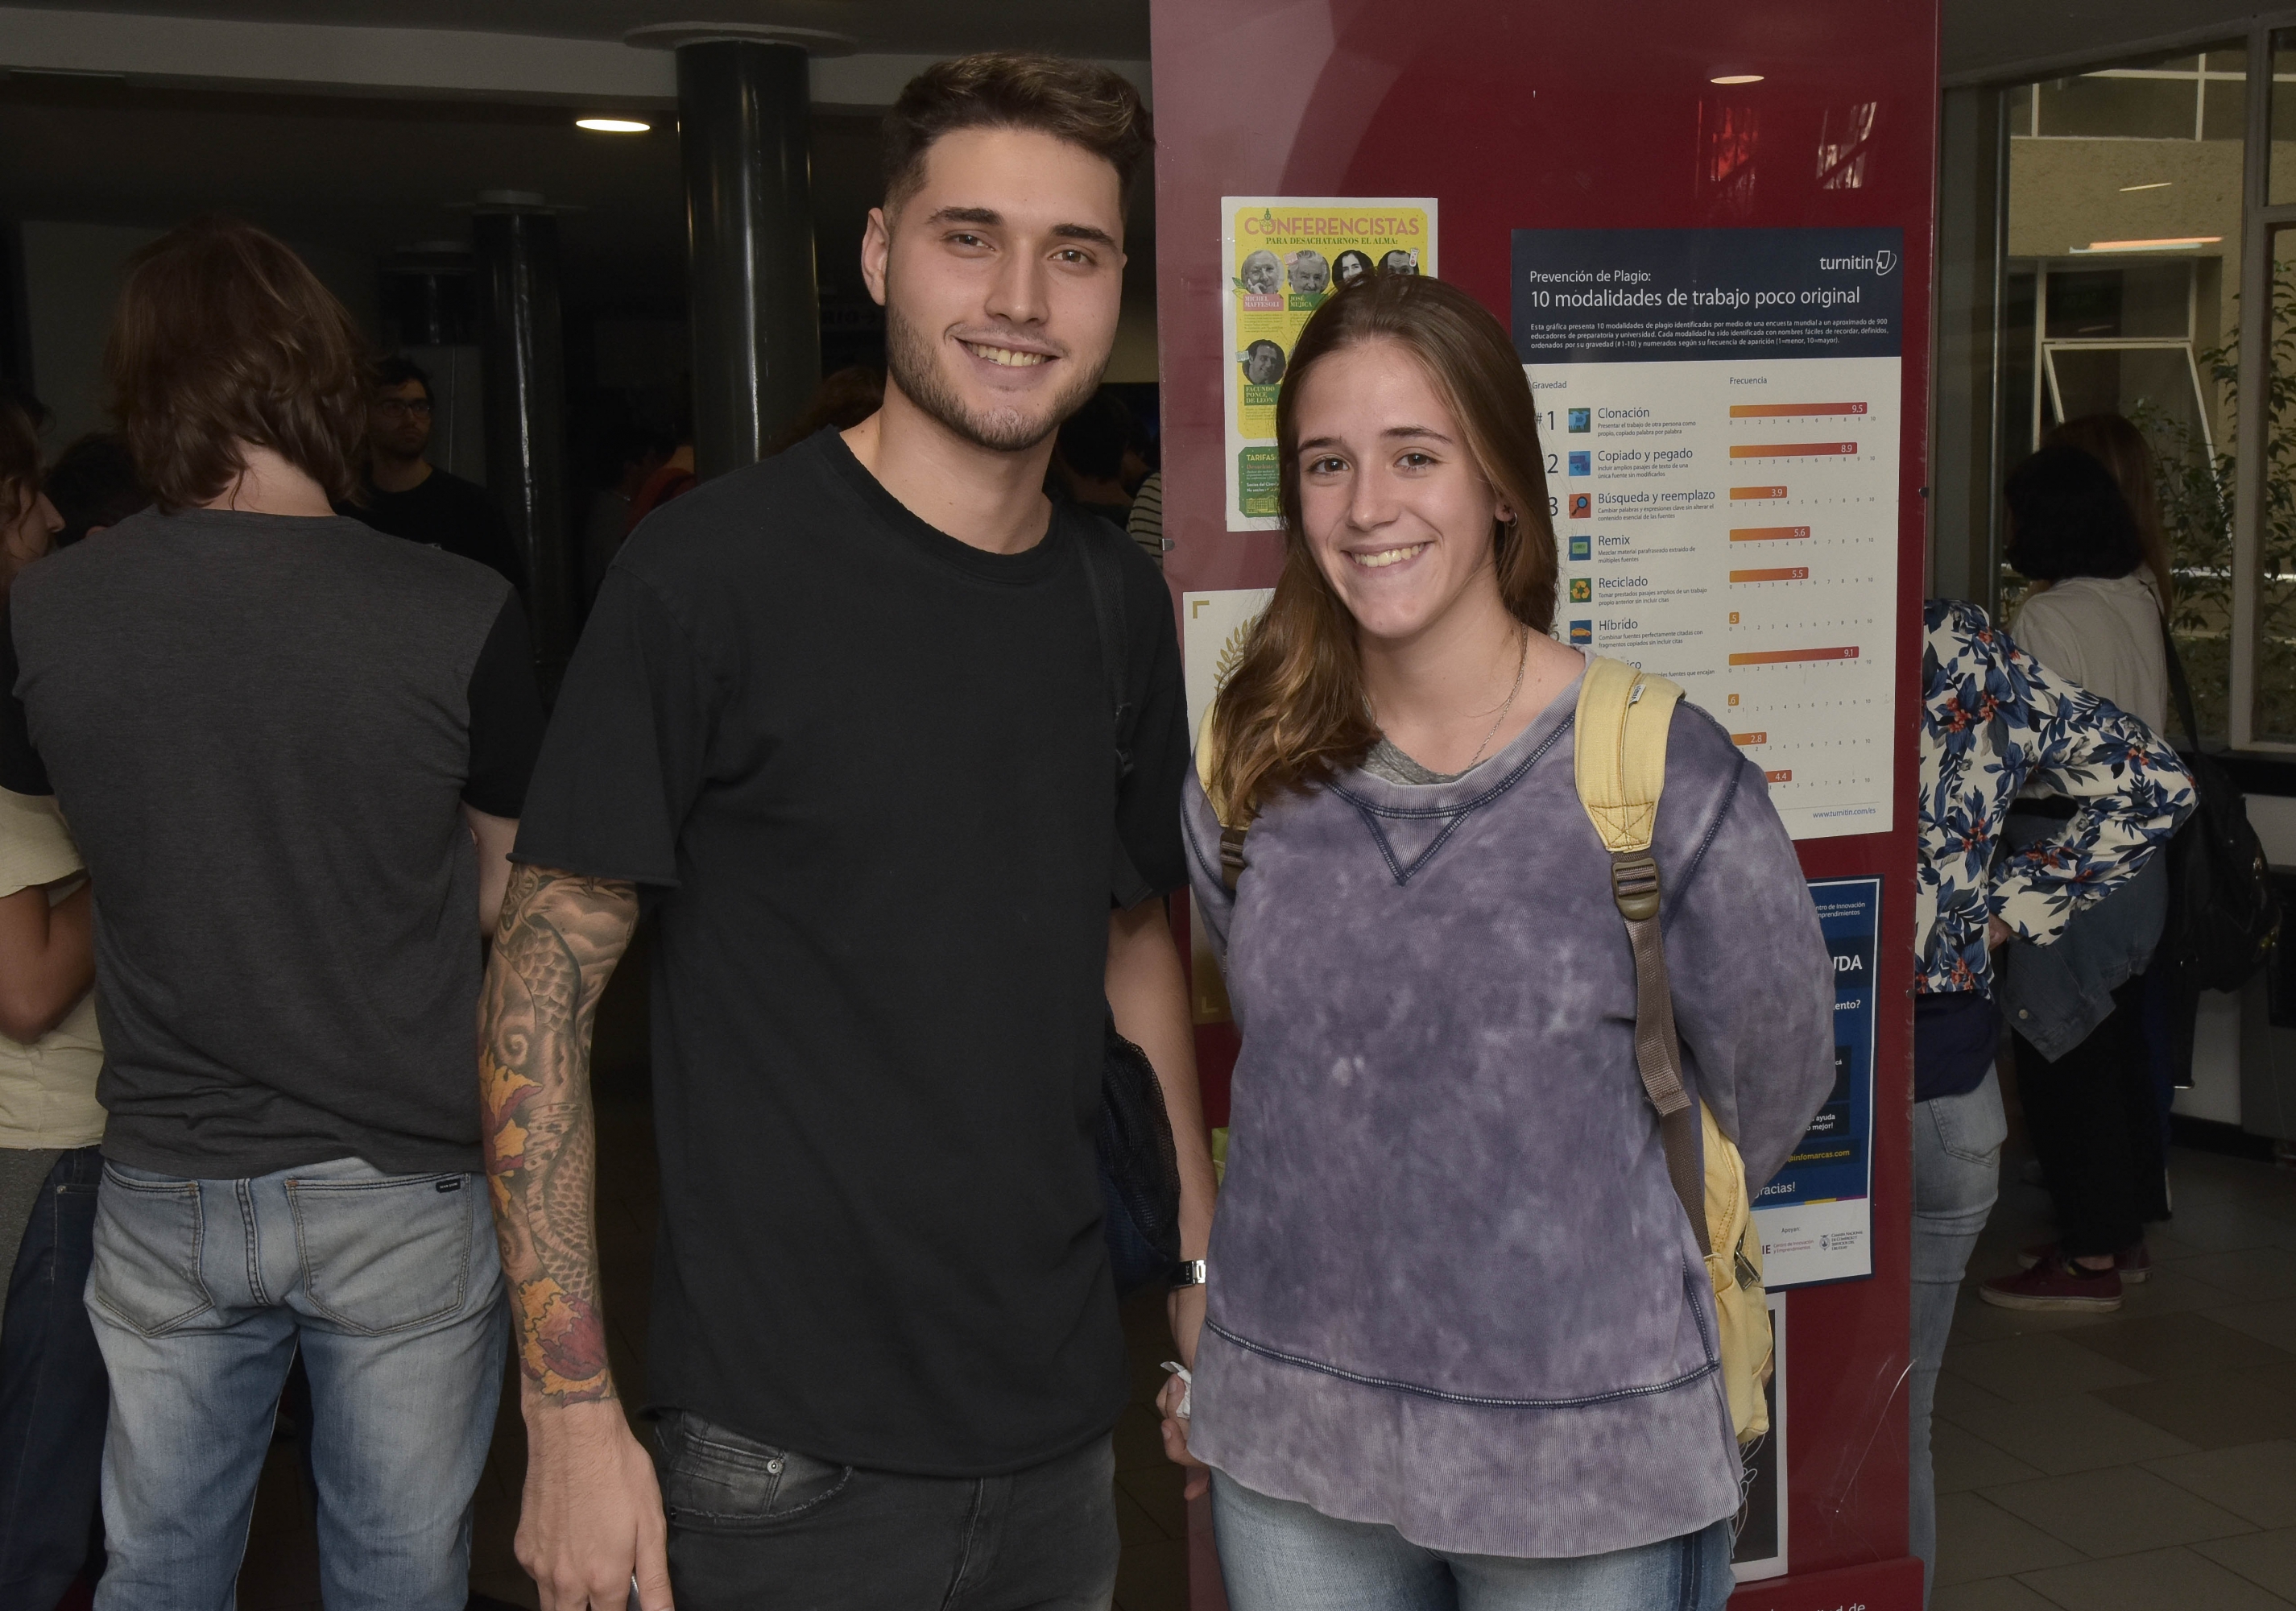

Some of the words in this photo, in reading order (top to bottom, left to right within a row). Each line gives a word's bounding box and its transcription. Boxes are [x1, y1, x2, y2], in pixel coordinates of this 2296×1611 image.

[1244, 217, 1419, 234] CONFERENCISTAS
[1819, 255, 1872, 269] turnitin
[1530, 271, 1592, 282] Prevención
[1596, 270, 1611, 281] de
[1614, 270, 1650, 284] Plagio:
[1532, 291, 1549, 307] 10
[1555, 289, 1661, 306] modalidades
[1667, 288, 1687, 305] de
[1692, 288, 1749, 309] trabajo
[1756, 292, 1795, 308] poco
[1801, 287, 1859, 307] original
[1545, 323, 1566, 331] gráfica
[1654, 321, 1673, 329] plagio
[1585, 341, 1613, 349] gravedad
[1533, 381, 1566, 389] Gravedad
[1730, 376, 1767, 384] Frecuencia
[1598, 407, 1649, 418] Clonación
[1851, 404, 1863, 412] 9.5
[1841, 444, 1852, 452] 8.9
[1598, 449, 1641, 462] Copiado
[1644, 452, 1650, 462] y
[1653, 448, 1692, 462] pegado
[1547, 453, 1558, 473] 2
[1772, 488, 1782, 496] 3.9
[1599, 491, 1649, 505] Búsqueda
[1652, 494, 1658, 504] y
[1661, 490, 1715, 502] reemplazo
[1549, 496, 1558, 516] 3
[1794, 528, 1805, 536] 5.6
[1599, 535, 1629, 545] Remix
[1792, 569, 1802, 578] 5.5
[1599, 576, 1648, 587] Reciclado
[1599, 619, 1637, 630] Híbrido
[1844, 649, 1853, 657] 9.1
[1751, 735, 1761, 743] 2.8
[1812, 808, 1876, 818] www.turnitin.com/es
[1816, 1113, 1835, 1122] ayuda
[1812, 1122, 1833, 1130] mejor!
